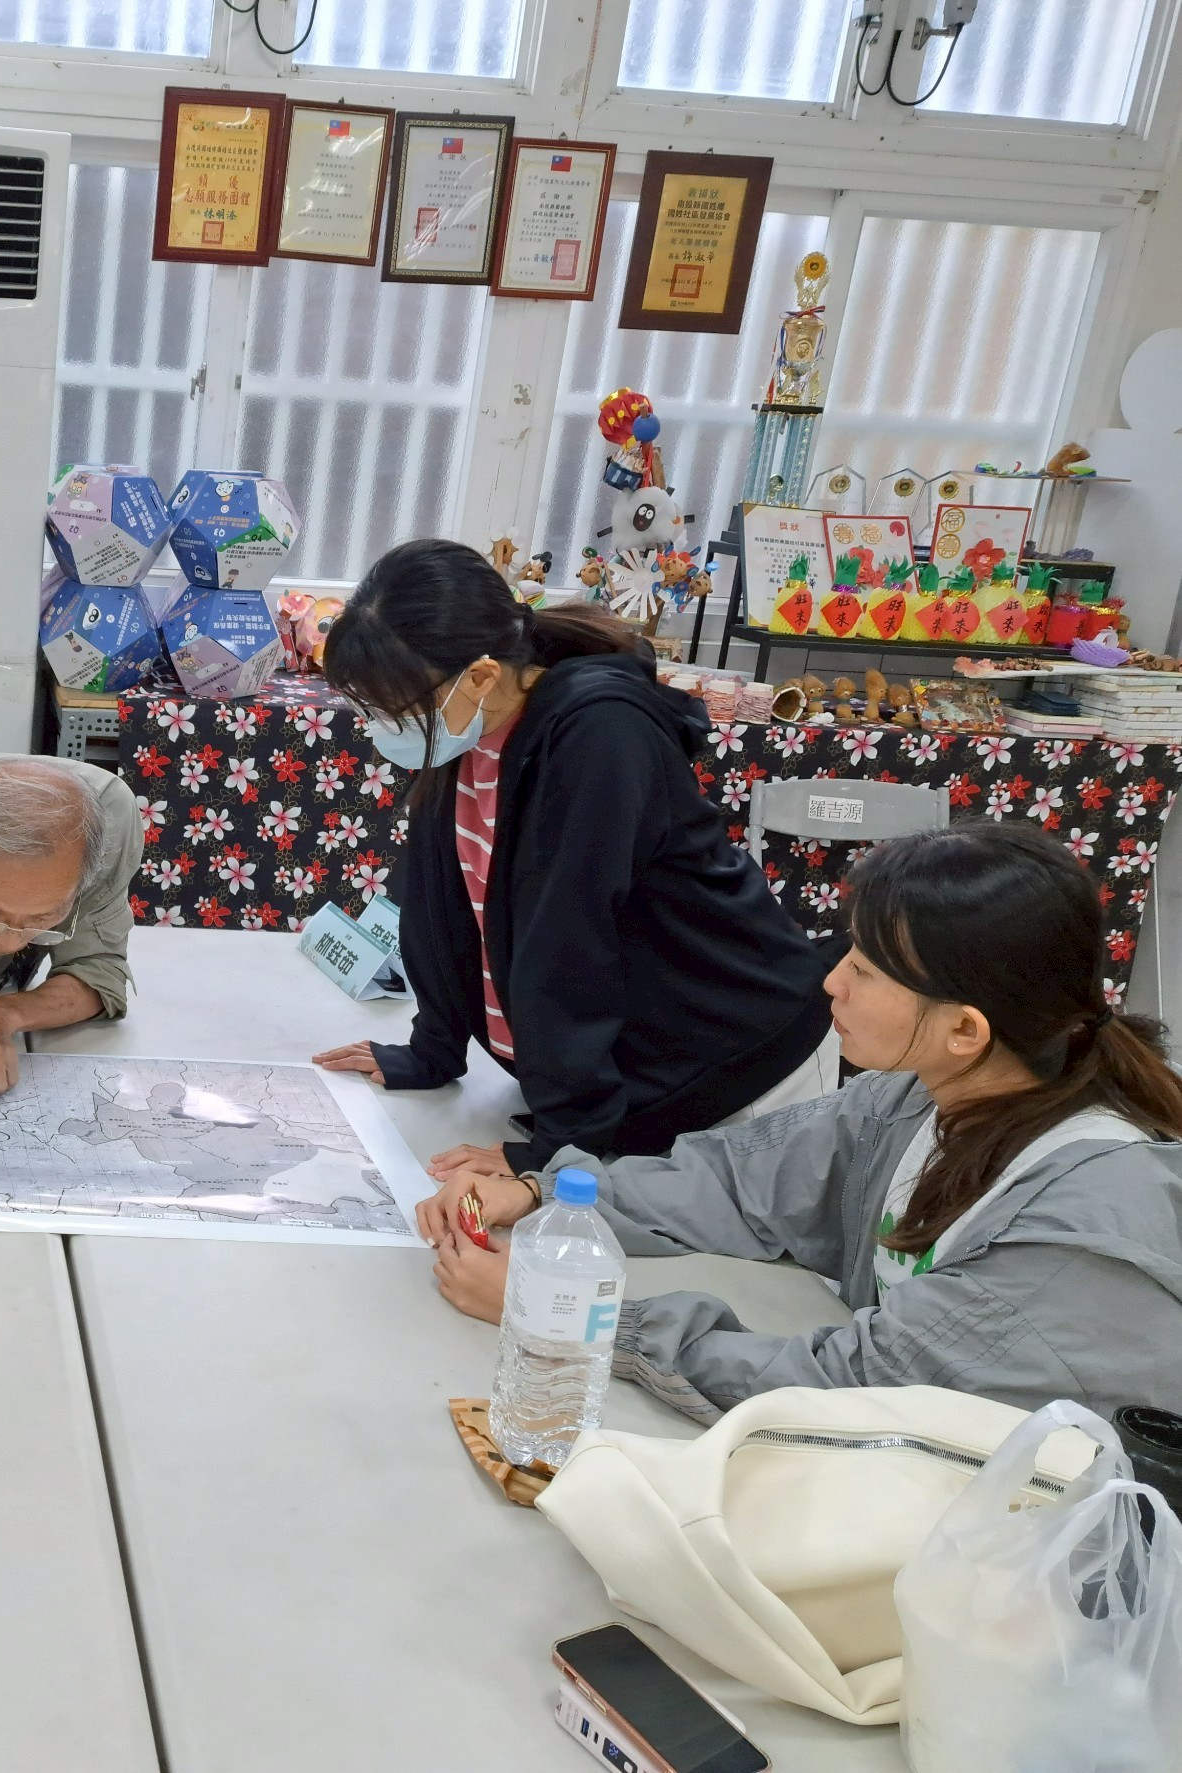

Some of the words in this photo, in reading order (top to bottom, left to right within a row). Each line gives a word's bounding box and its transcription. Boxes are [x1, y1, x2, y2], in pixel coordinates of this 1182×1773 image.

[213, 528, 226, 537] Q3
[251, 534, 263, 543] Q4
[952, 601, 970, 635] 旺來
[1002, 600, 1020, 633] 旺來
[809, 800, 863, 821] 羅吉源
[314, 932, 359, 976] 林鈺茹
[554, 1293, 578, 1302] 天然水
